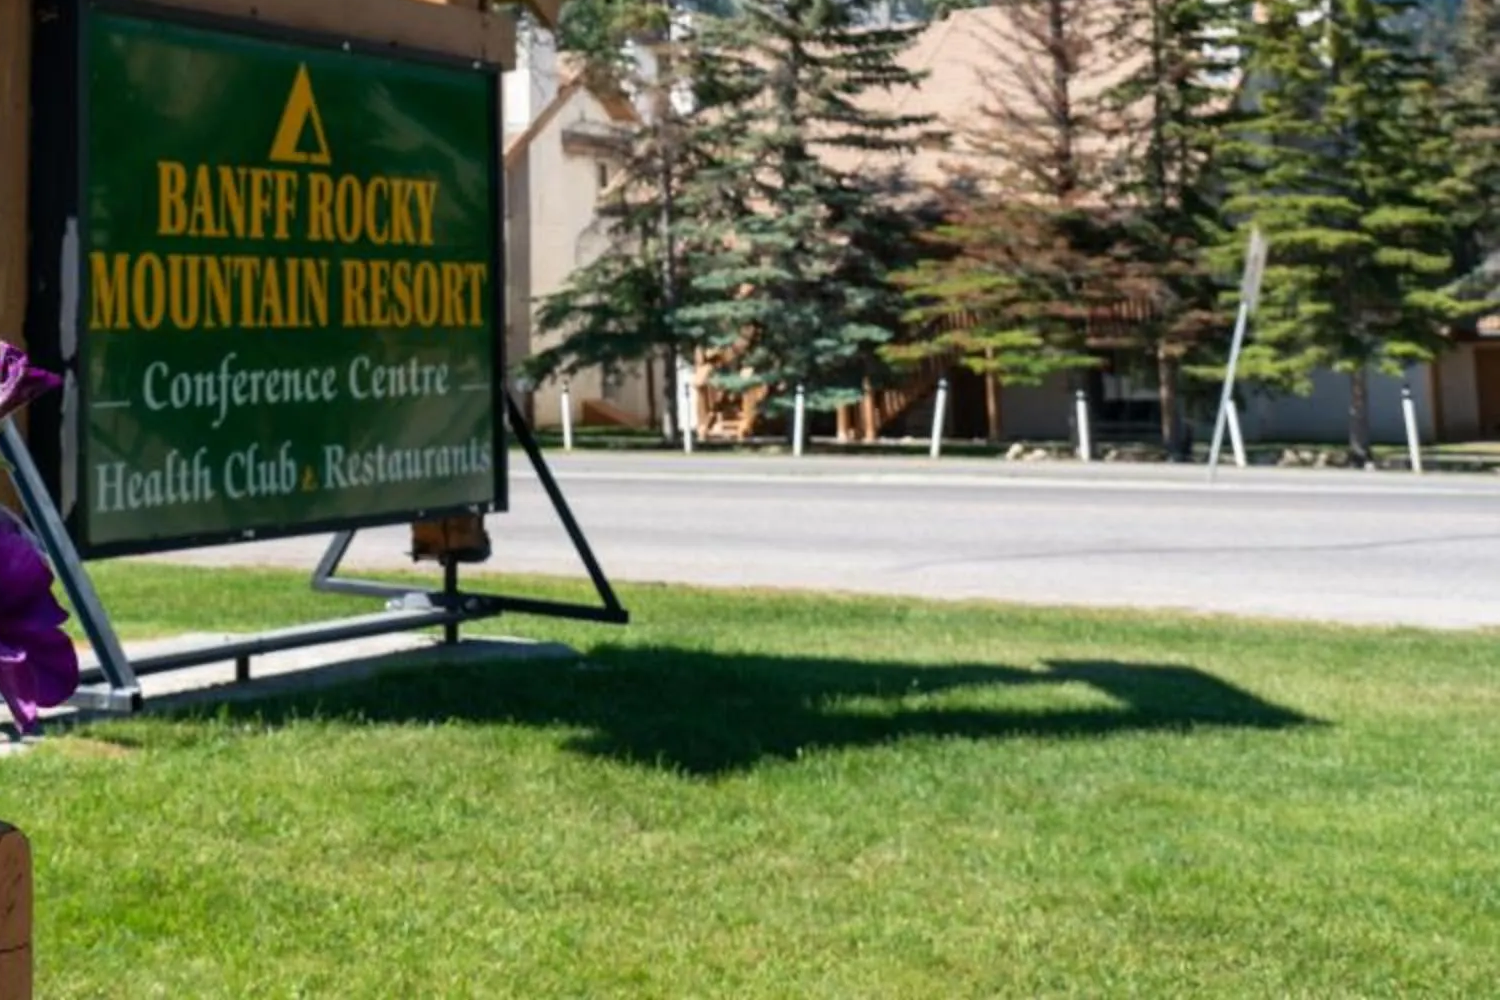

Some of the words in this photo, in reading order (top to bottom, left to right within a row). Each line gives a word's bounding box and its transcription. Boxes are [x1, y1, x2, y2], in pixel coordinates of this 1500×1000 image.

[157, 161, 299, 238] BANFF
[308, 172, 437, 245] ROCKY
[89, 251, 329, 331] MOUNTAIN
[342, 260, 488, 327] RESORT
[143, 352, 338, 428] Conference
[348, 354, 450, 397] Centre
[95, 447, 215, 512] Health
[223, 440, 298, 498] Club
[323, 437, 492, 489] Restaurants
